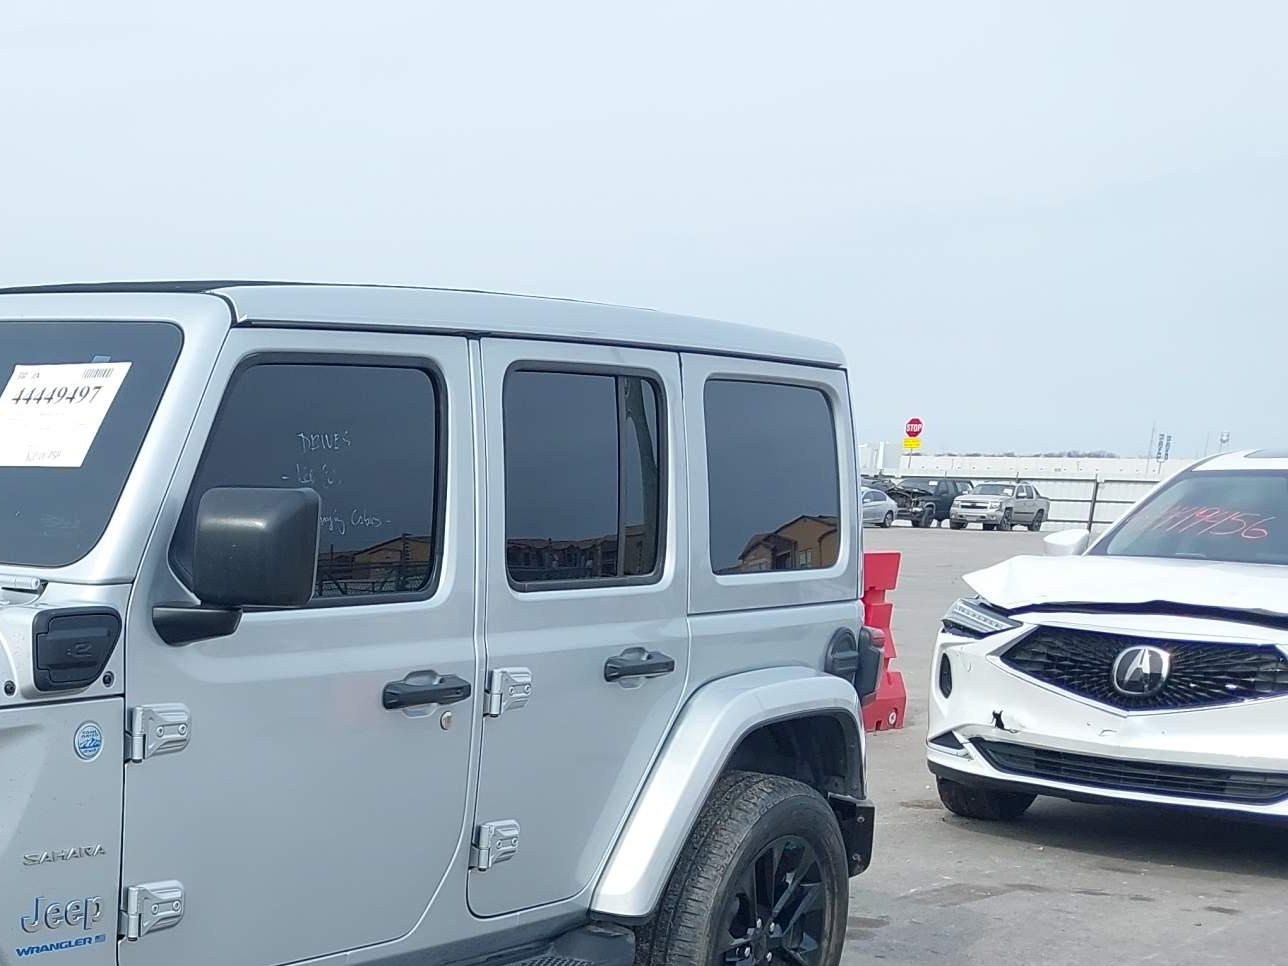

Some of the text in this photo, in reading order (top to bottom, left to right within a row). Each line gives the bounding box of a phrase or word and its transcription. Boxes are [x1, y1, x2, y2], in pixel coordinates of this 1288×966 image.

[11, 385, 103, 405] 44449497
[906, 423, 923, 432] STOP
[23, 844, 106, 866] SAHARA
[20, 896, 103, 934] Jeep
[15, 936, 93, 957] WRANGLER
